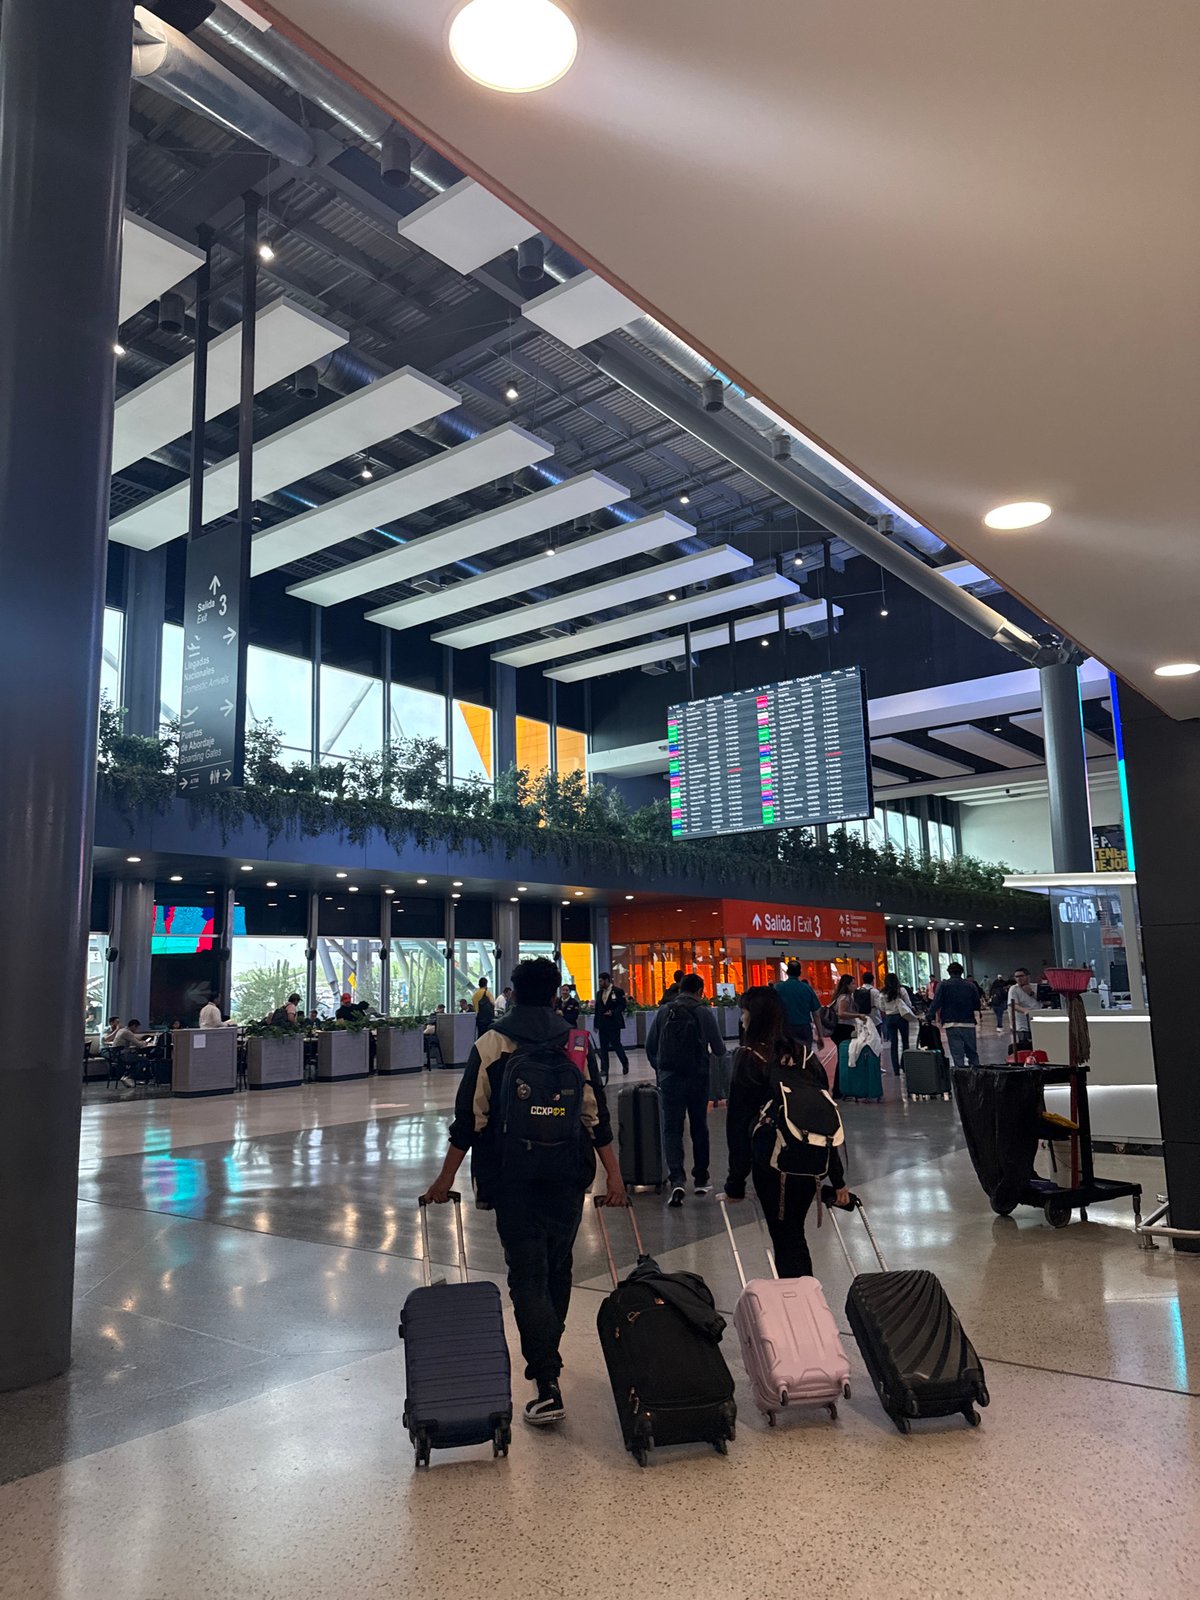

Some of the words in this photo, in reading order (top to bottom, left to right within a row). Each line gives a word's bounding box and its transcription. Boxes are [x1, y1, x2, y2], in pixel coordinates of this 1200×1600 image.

[197, 599, 216, 613] Salida
[218, 594, 227, 616] 3
[196, 612, 208, 624] Exit
[184, 656, 210, 671] Llegadas
[181, 728, 203, 740] Puertas
[180, 743, 188, 752] de
[188, 736, 215, 751] Abordaje
[179, 751, 205, 765] Boarding
[205, 748, 222, 760] Gates
[764, 913, 791, 932] Salida
[797, 915, 813, 933] Exit
[814, 914, 821, 938] 3
